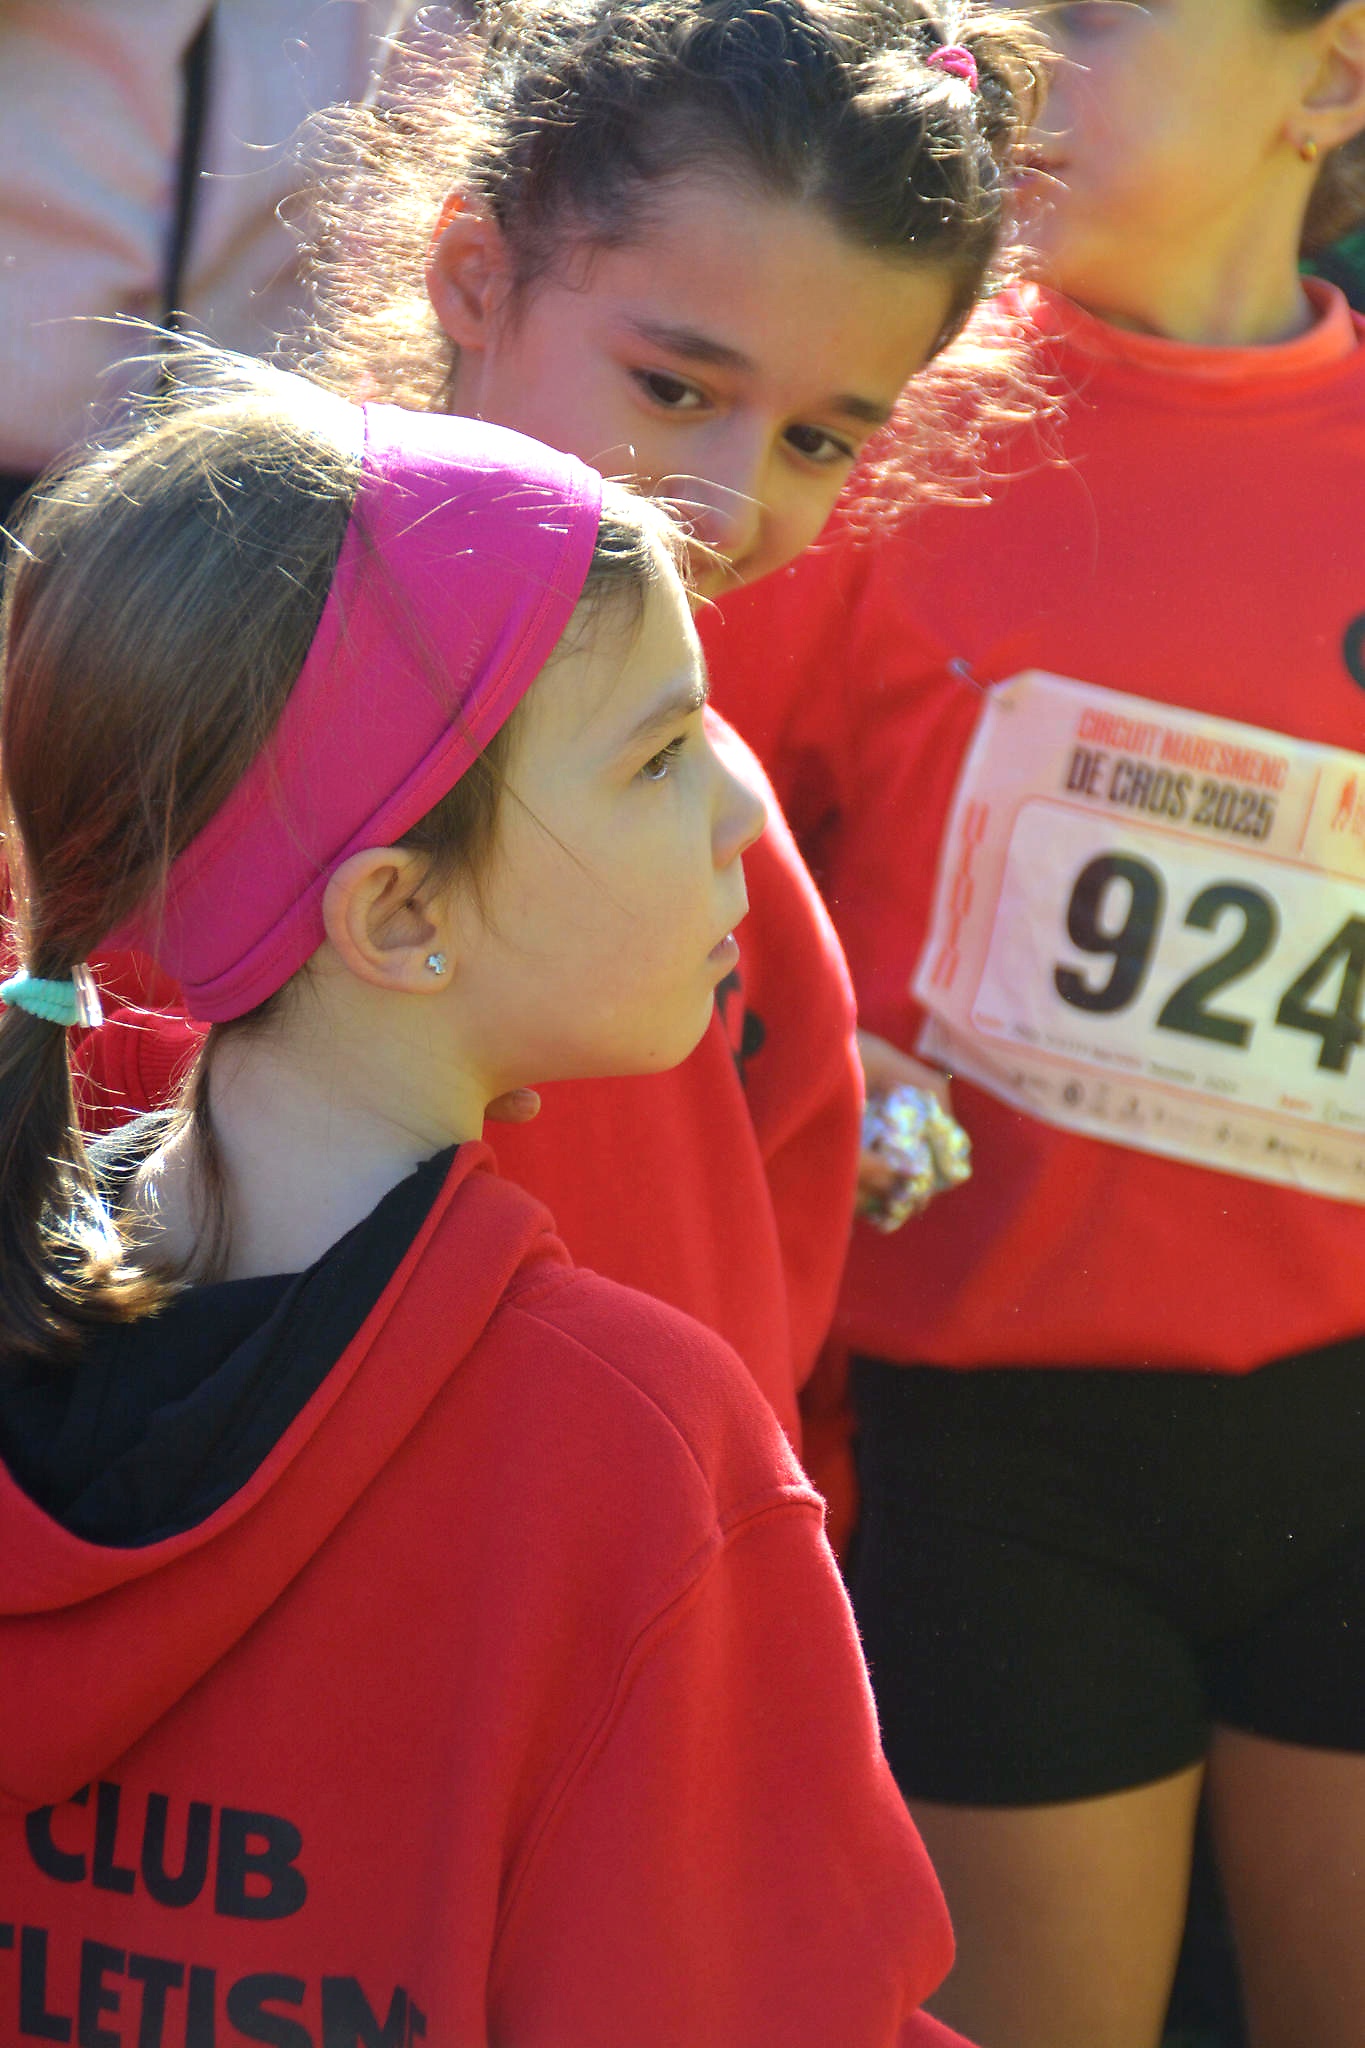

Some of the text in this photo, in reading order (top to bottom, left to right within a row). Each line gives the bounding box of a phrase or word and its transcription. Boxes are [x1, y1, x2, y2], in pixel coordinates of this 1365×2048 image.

[1066, 744, 1108, 796] DE
[1109, 757, 1193, 821] CROS
[1191, 778, 1279, 842] 2025
[1076, 707, 1159, 757] CIRCUIT
[1053, 850, 1365, 1076] 924
[25, 1780, 308, 1921] CLUB
[0, 1922, 427, 2048] LETISM
